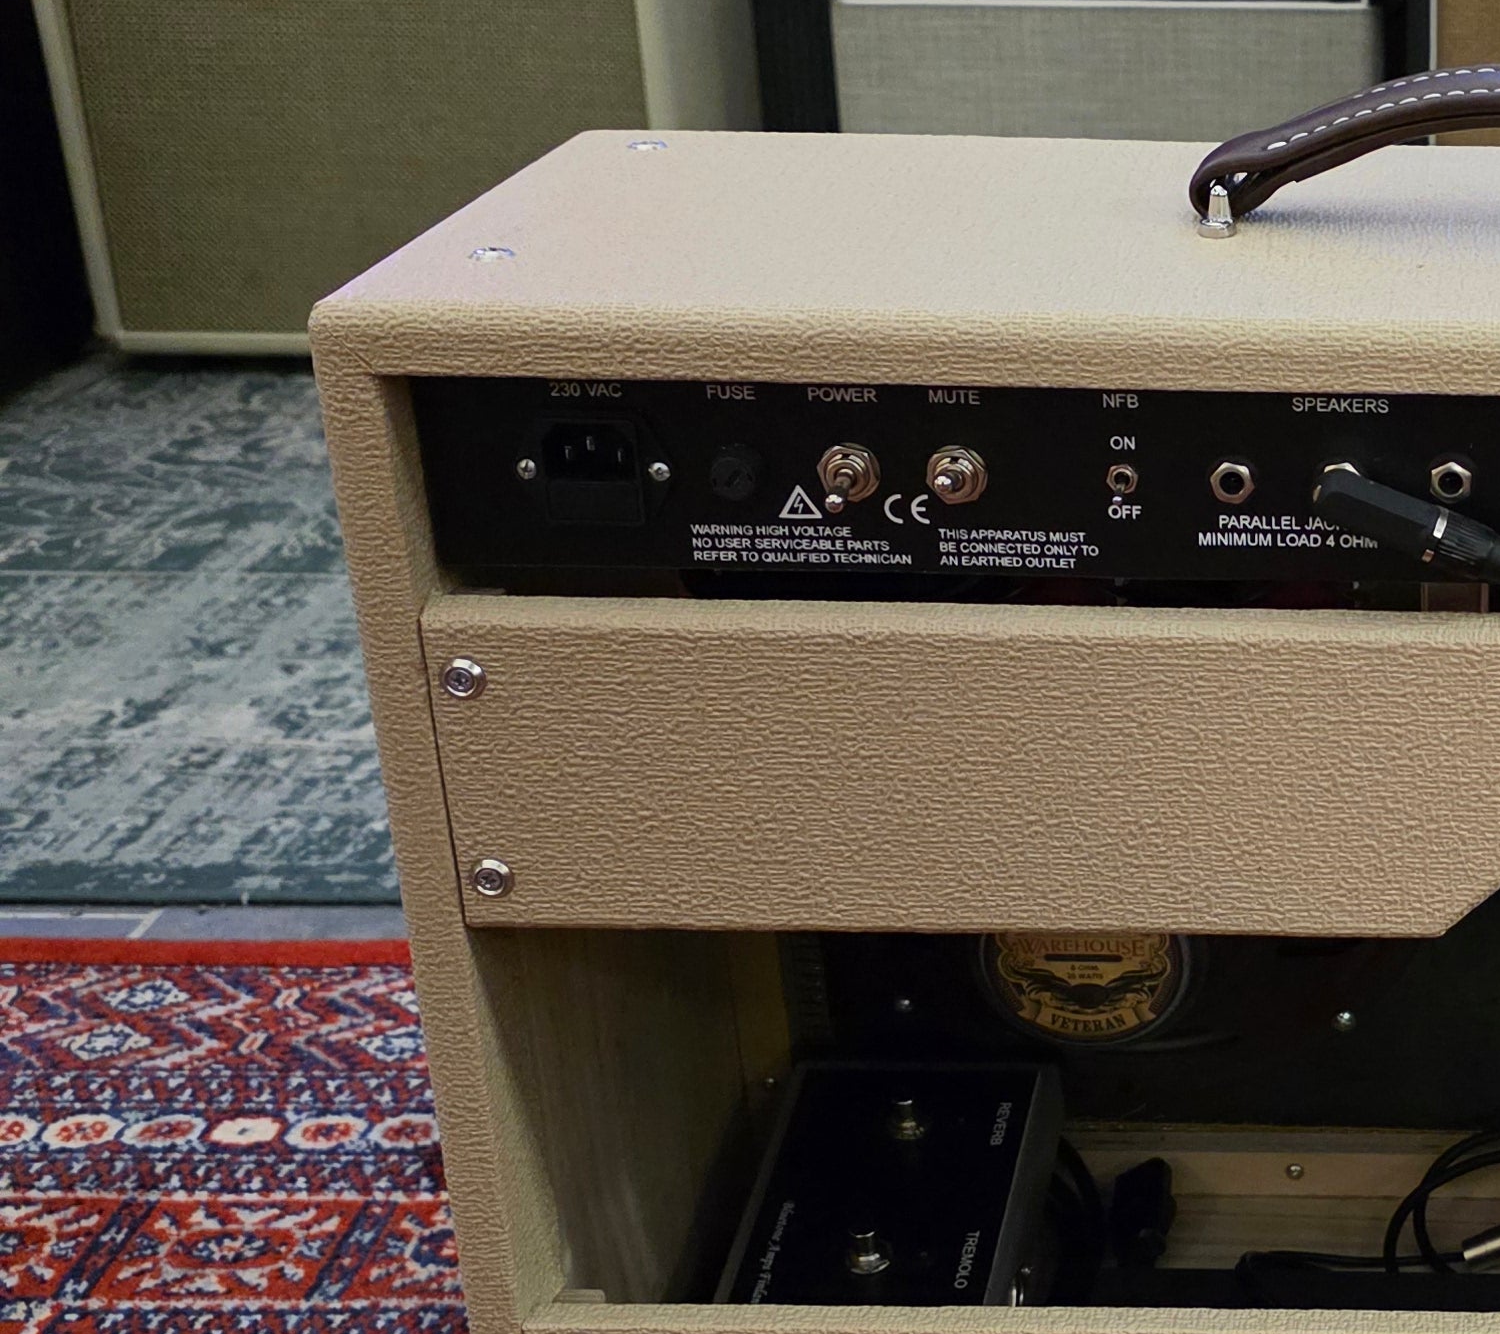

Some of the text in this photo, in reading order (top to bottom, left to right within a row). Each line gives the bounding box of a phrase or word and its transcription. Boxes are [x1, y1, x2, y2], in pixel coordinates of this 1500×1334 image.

[550, 382, 623, 398] 230 VAC
[706, 384, 756, 400] FUSE
[807, 386, 878, 403] POWER
[928, 389, 981, 405] MUTE
[1102, 393, 1139, 409] NFB
[1292, 397, 1389, 413] SPEAKERS
[1109, 435, 1136, 451] ON
[1107, 504, 1142, 520] OFF
[690, 523, 852, 538] WARNING HIGH VOLTAGE
[1218, 515, 1300, 530] PARALLEL
[938, 528, 1086, 543] THIS APPARATUS MUST
[1198, 531, 1273, 547] MINIMUM
[1276, 532, 1322, 548] LOAD
[1325, 533, 1335, 548] 4
[691, 537, 890, 552] NO USER SERVICEABLE PARTS
[939, 541, 1100, 556] BE CONNECTED ONLY TO
[693, 550, 913, 565] REFER TO QUALIFIED TECHNICIAN
[939, 555, 1077, 569] AN EARTHED OUTLET
[1018, 938, 1146, 957] WAREHOUSE
[1050, 1013, 1127, 1033] VETERAN
[990, 1101, 1012, 1146] REVERB
[954, 1230, 980, 1289] TREMOLO
